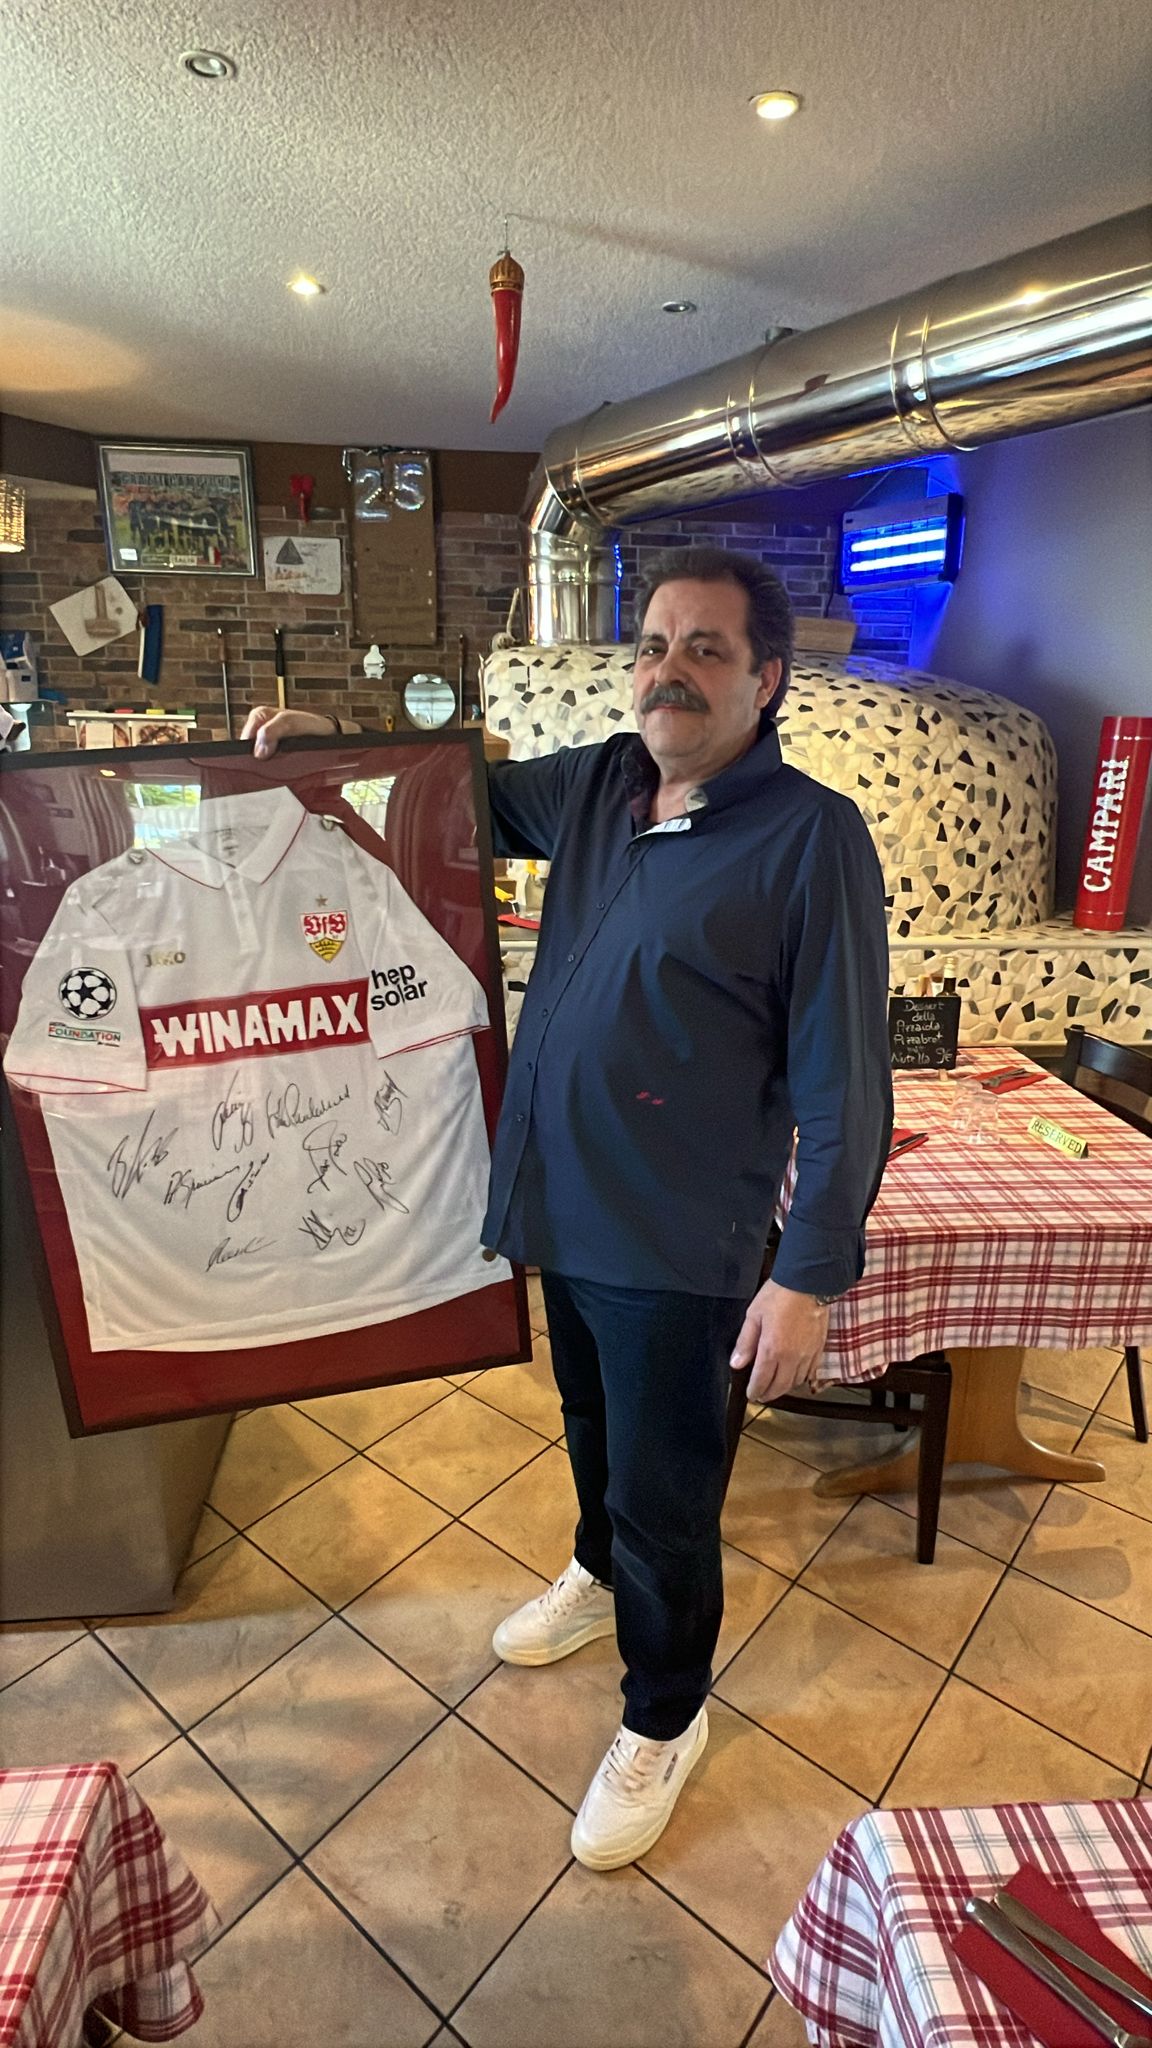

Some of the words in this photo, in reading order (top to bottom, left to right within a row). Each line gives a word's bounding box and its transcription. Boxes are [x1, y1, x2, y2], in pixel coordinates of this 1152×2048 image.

[1083, 759, 1129, 893] CAMPARI
[303, 913, 346, 936] VfB
[145, 951, 186, 968] JKO
[371, 964, 416, 989] hep
[370, 980, 428, 1011] solar
[150, 992, 364, 1057] WINAMAX
[911, 1011, 936, 1022] della
[48, 1024, 120, 1042] FOUNDATION
[890, 1052, 931, 1065] Nutella
[1031, 1120, 1082, 1154] RESERVED
